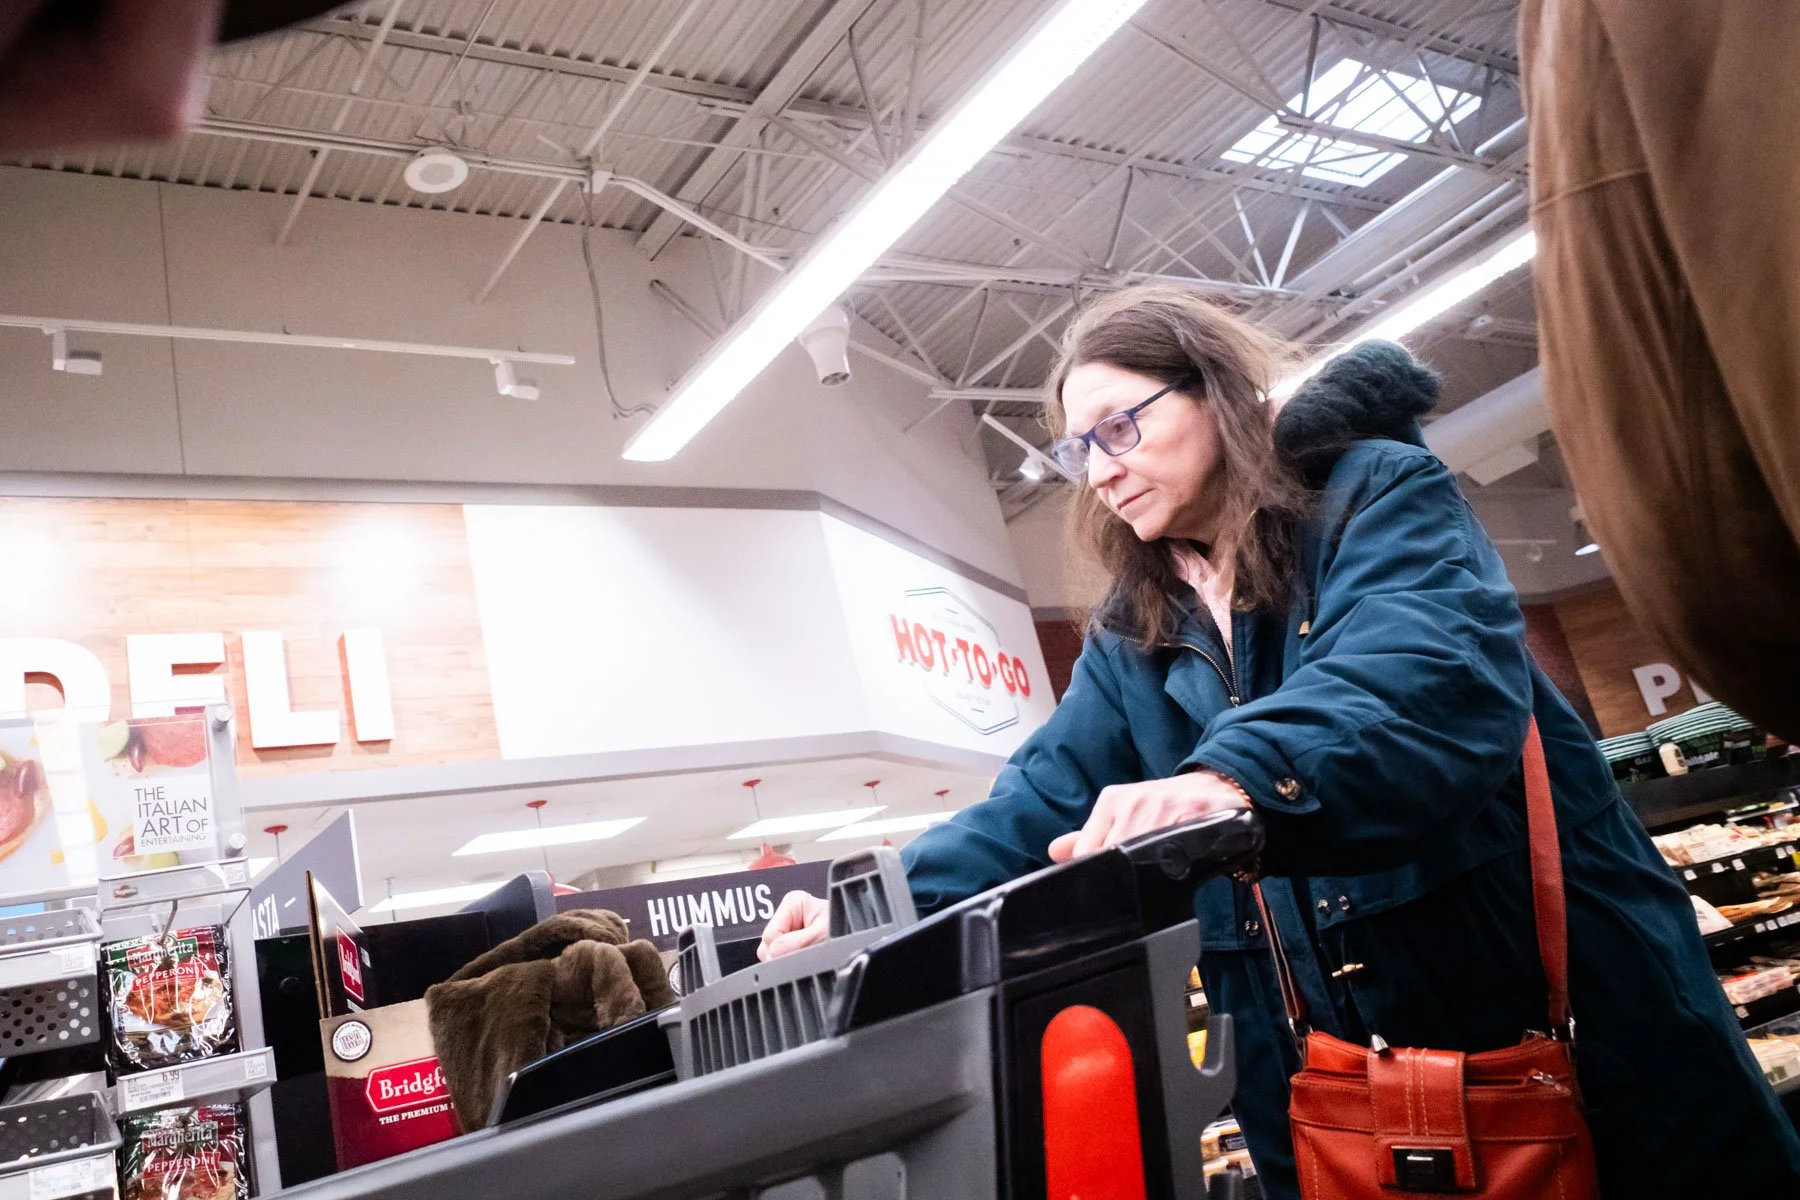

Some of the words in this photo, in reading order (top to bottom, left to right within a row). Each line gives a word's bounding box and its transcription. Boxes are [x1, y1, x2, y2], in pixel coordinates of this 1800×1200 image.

[134, 786, 165, 802] THE
[138, 797, 207, 818] ITALIAN
[142, 815, 182, 838] ART
[186, 818, 208, 833] OF
[141, 833, 207, 847] ENTERTAINING
[252, 893, 280, 940] ASTA
[647, 883, 775, 937] HUMMUS
[340, 1029, 364, 1052] USA
[379, 1114, 400, 1125] THE
[401, 1103, 449, 1121] PREMIUM
[147, 1125, 214, 1150] Margherita
